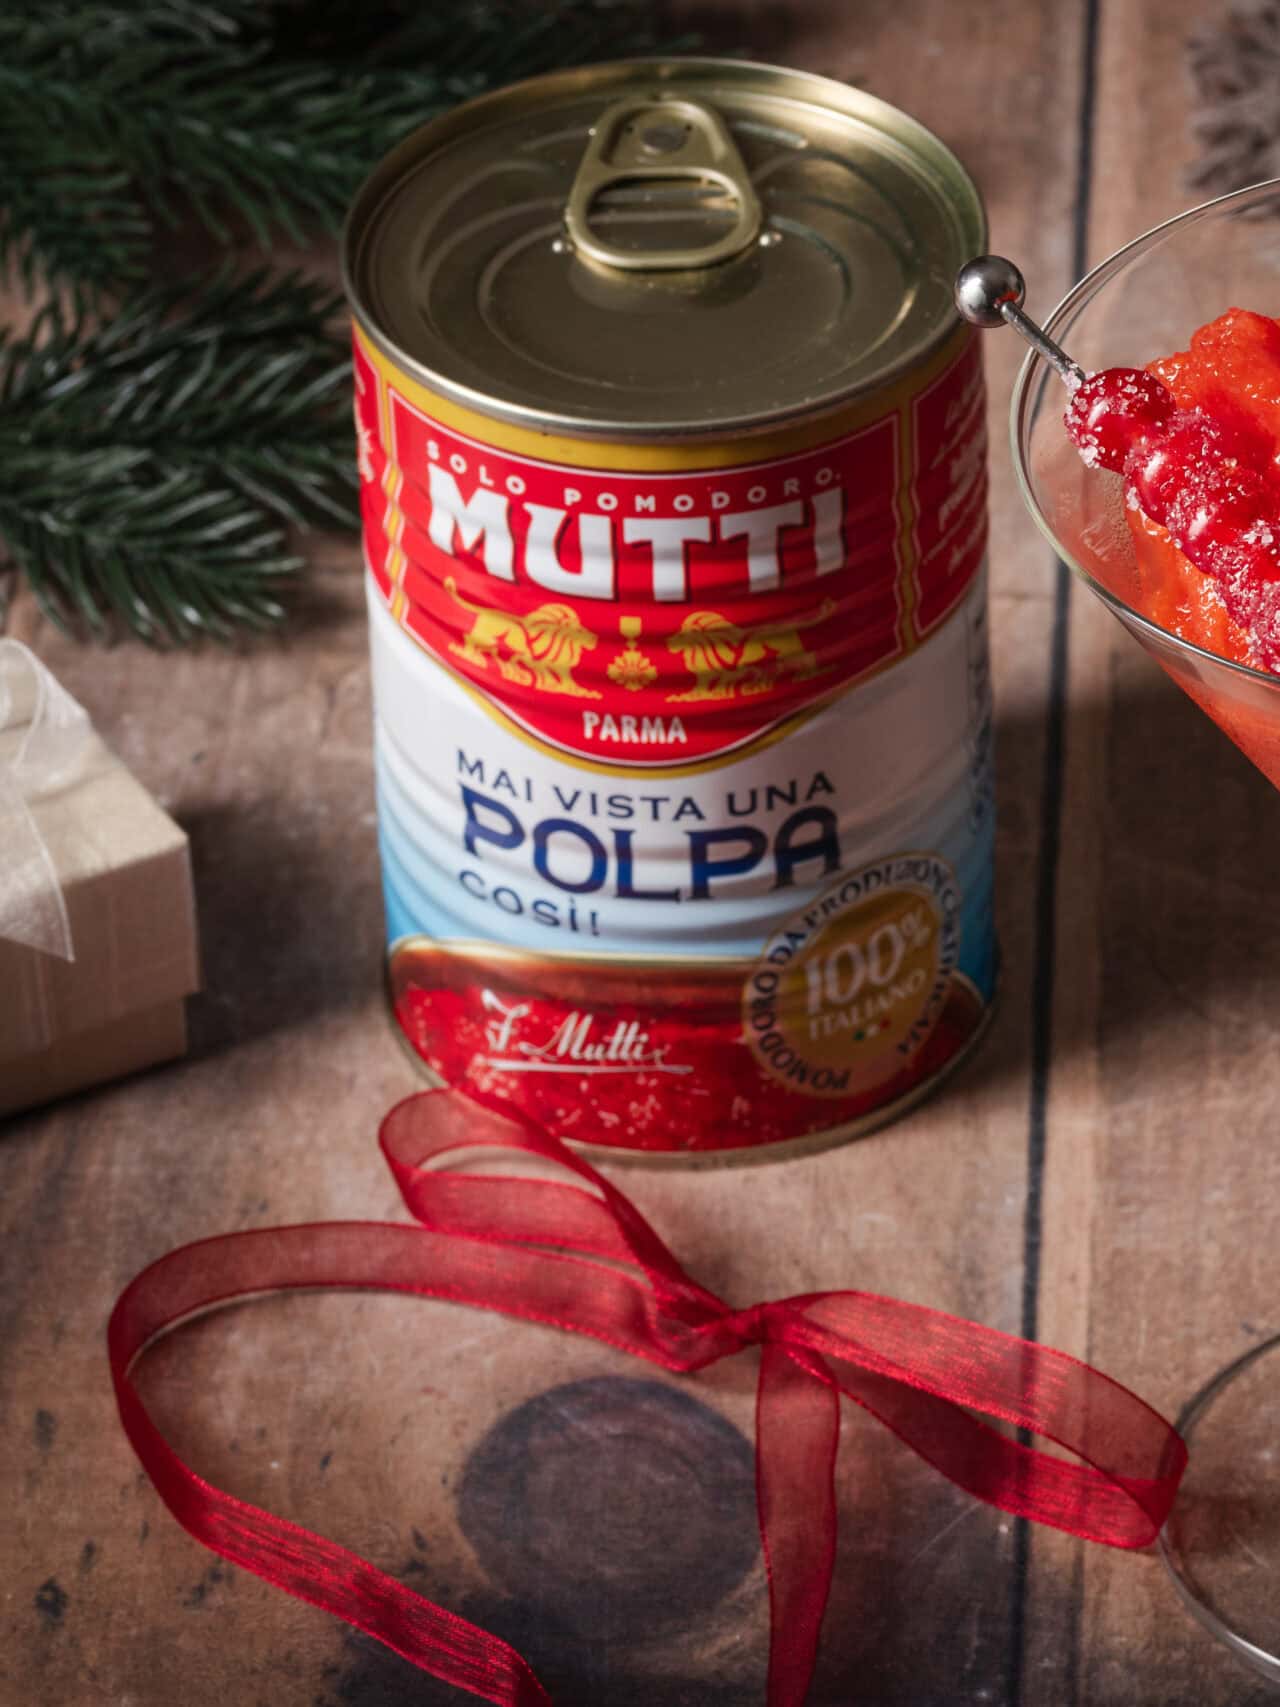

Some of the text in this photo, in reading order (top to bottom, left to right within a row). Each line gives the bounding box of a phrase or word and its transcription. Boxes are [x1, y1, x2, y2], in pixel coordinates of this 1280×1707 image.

[426, 440, 527, 495] SOLO
[427, 463, 850, 602] MUTTI
[582, 711, 688, 745] PARMA
[456, 748, 837, 822] MAI VISTA UNA
[458, 783, 842, 903] POLPA
[768, 930, 806, 966] DA
[804, 910, 932, 1015] 100%
[808, 968, 928, 1041] ITALIANO
